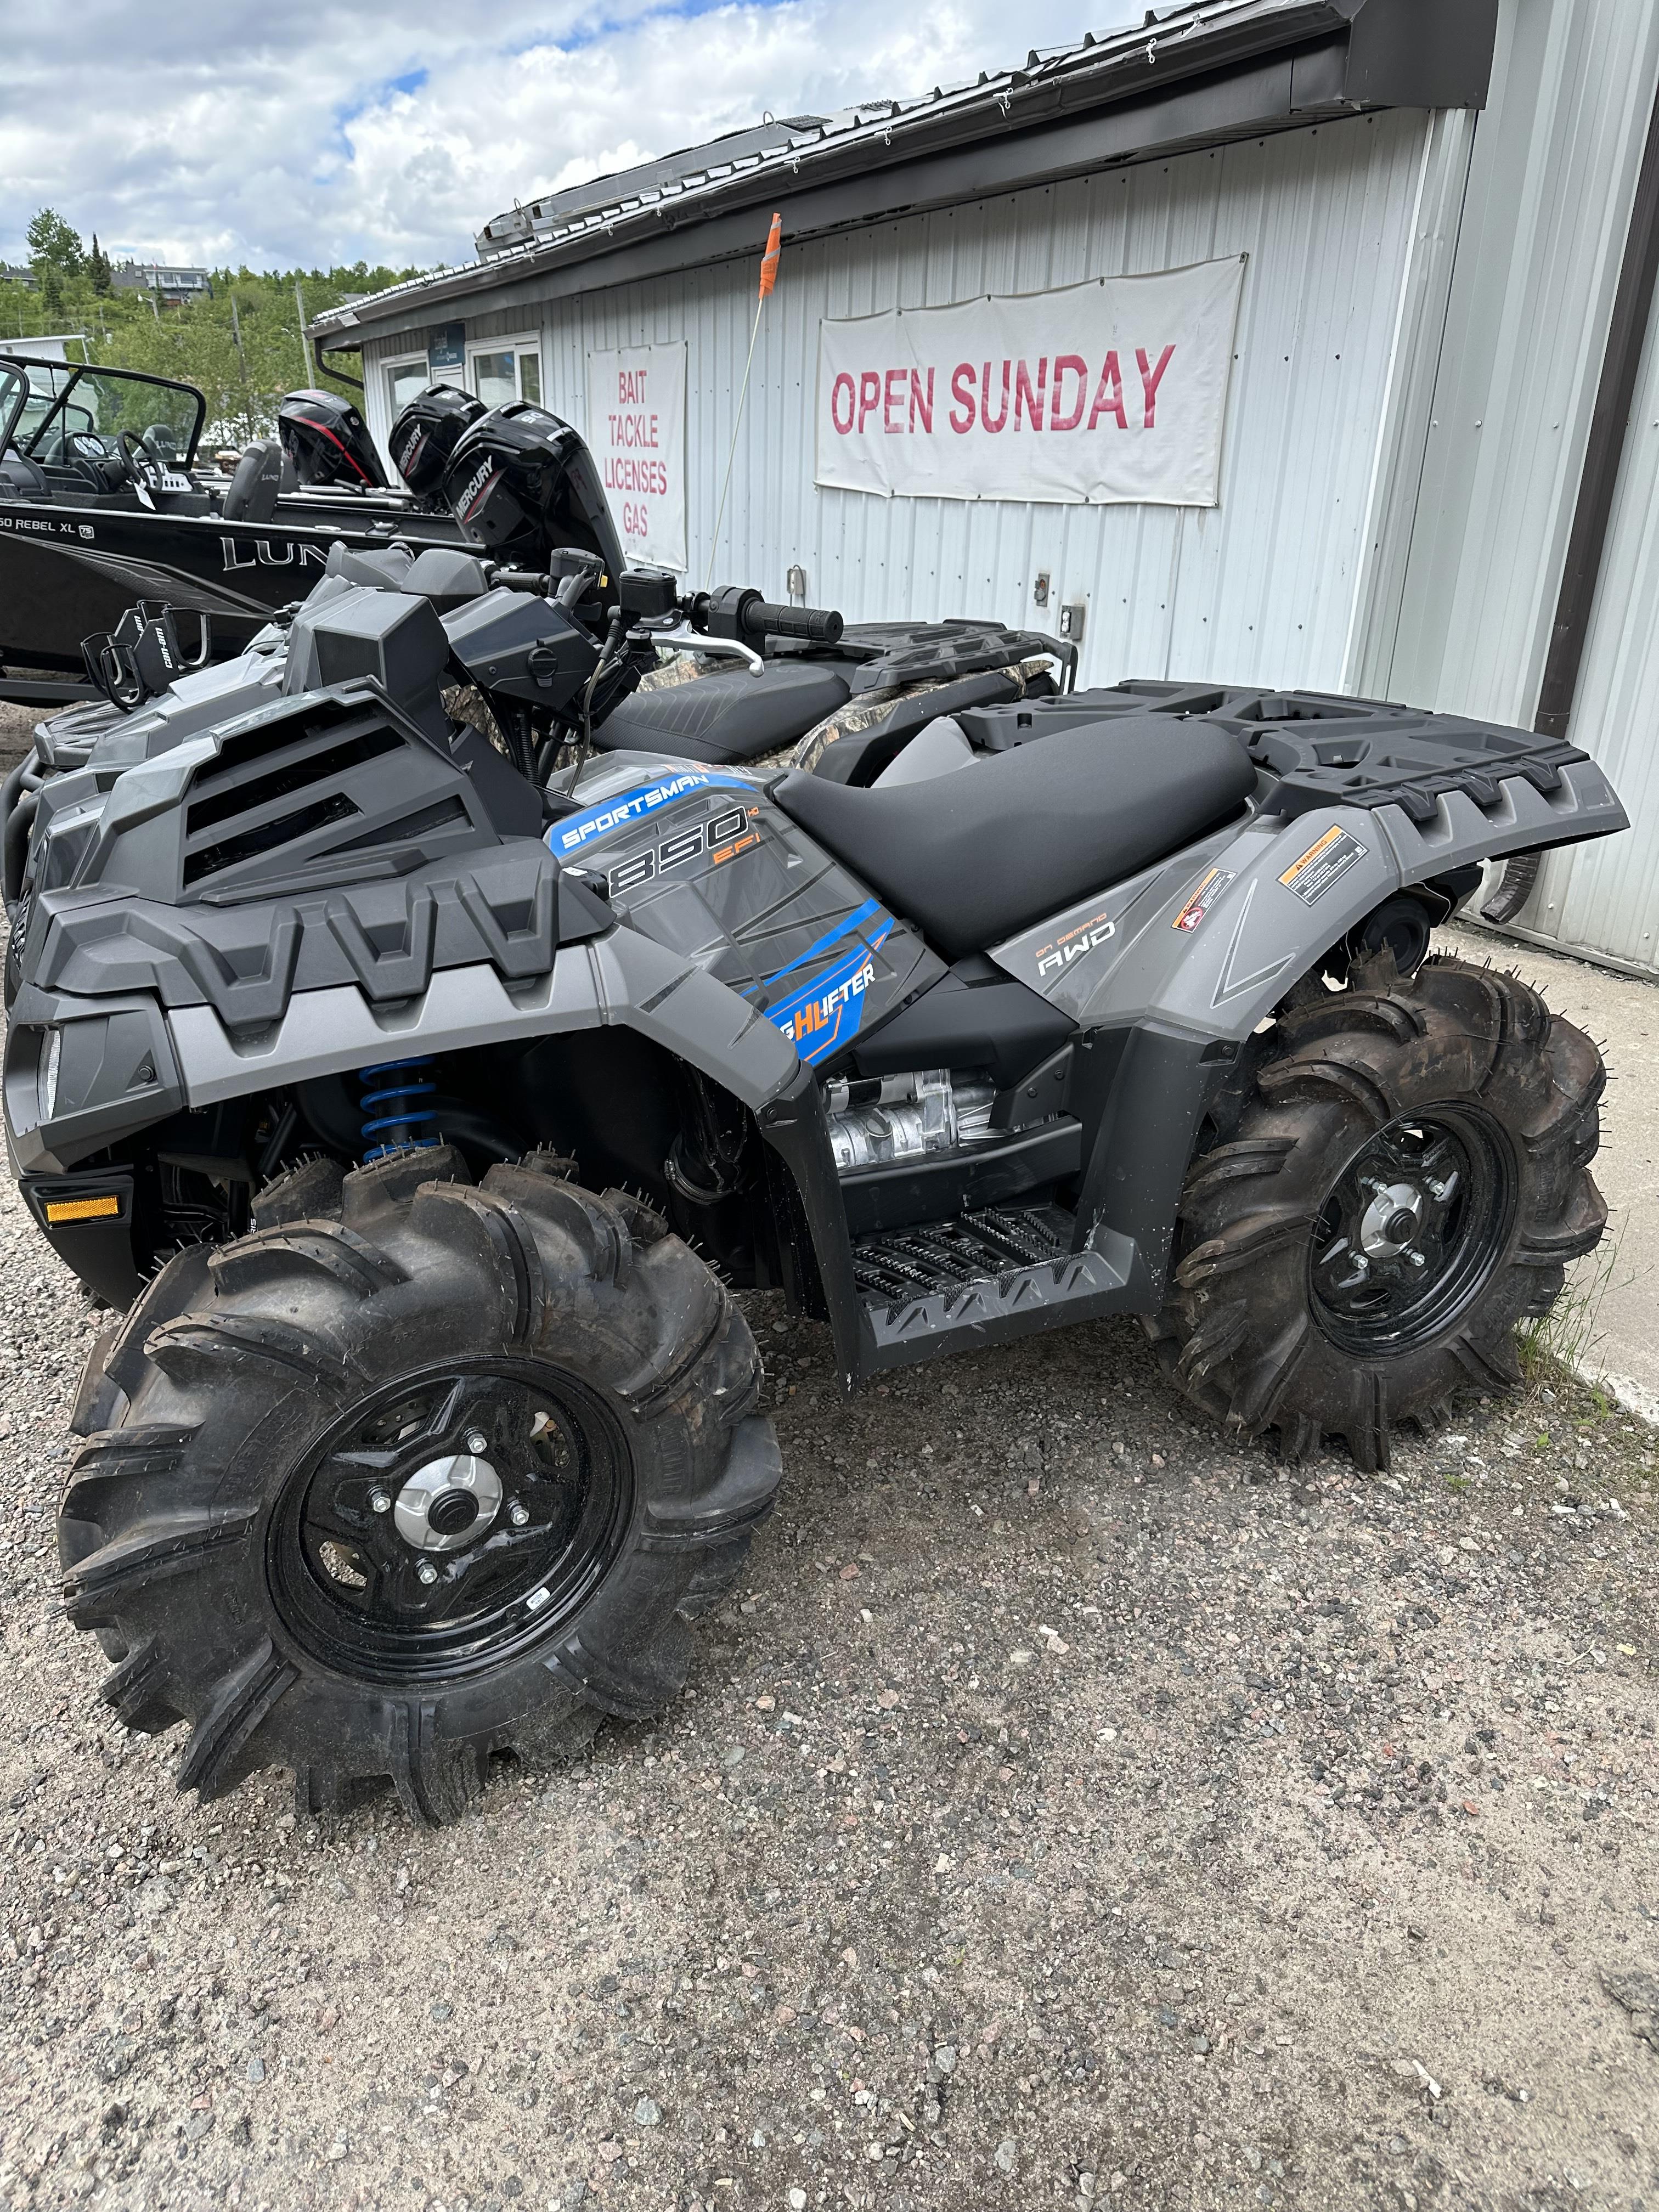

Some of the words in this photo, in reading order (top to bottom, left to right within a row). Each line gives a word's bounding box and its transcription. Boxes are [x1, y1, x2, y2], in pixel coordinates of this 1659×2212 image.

[618, 370, 647, 404] BAIT
[831, 367, 935, 435] OPEN
[949, 344, 1176, 434] SUNDAY
[521, 412, 544, 424] 90
[608, 414, 659, 448] TACKLE
[399, 423, 421, 475] MERCURY
[455, 455, 493, 520] MERCURY
[605, 458, 668, 495] LICENSES
[15, 519, 56, 531] REBEL
[60, 523, 76, 533] XL
[623, 501, 648, 537] GAS
[219, 537, 329, 571] LUN
[561, 774, 709, 849] SPORTSMAN
[608, 805, 749, 899] 850
[747, 806, 760, 817] HO
[713, 832, 761, 865] EFI
[1301, 840, 1328, 864] WARNING
[1037, 921, 1116, 977] AWD
[780, 963, 877, 1041] GHLIFTER
